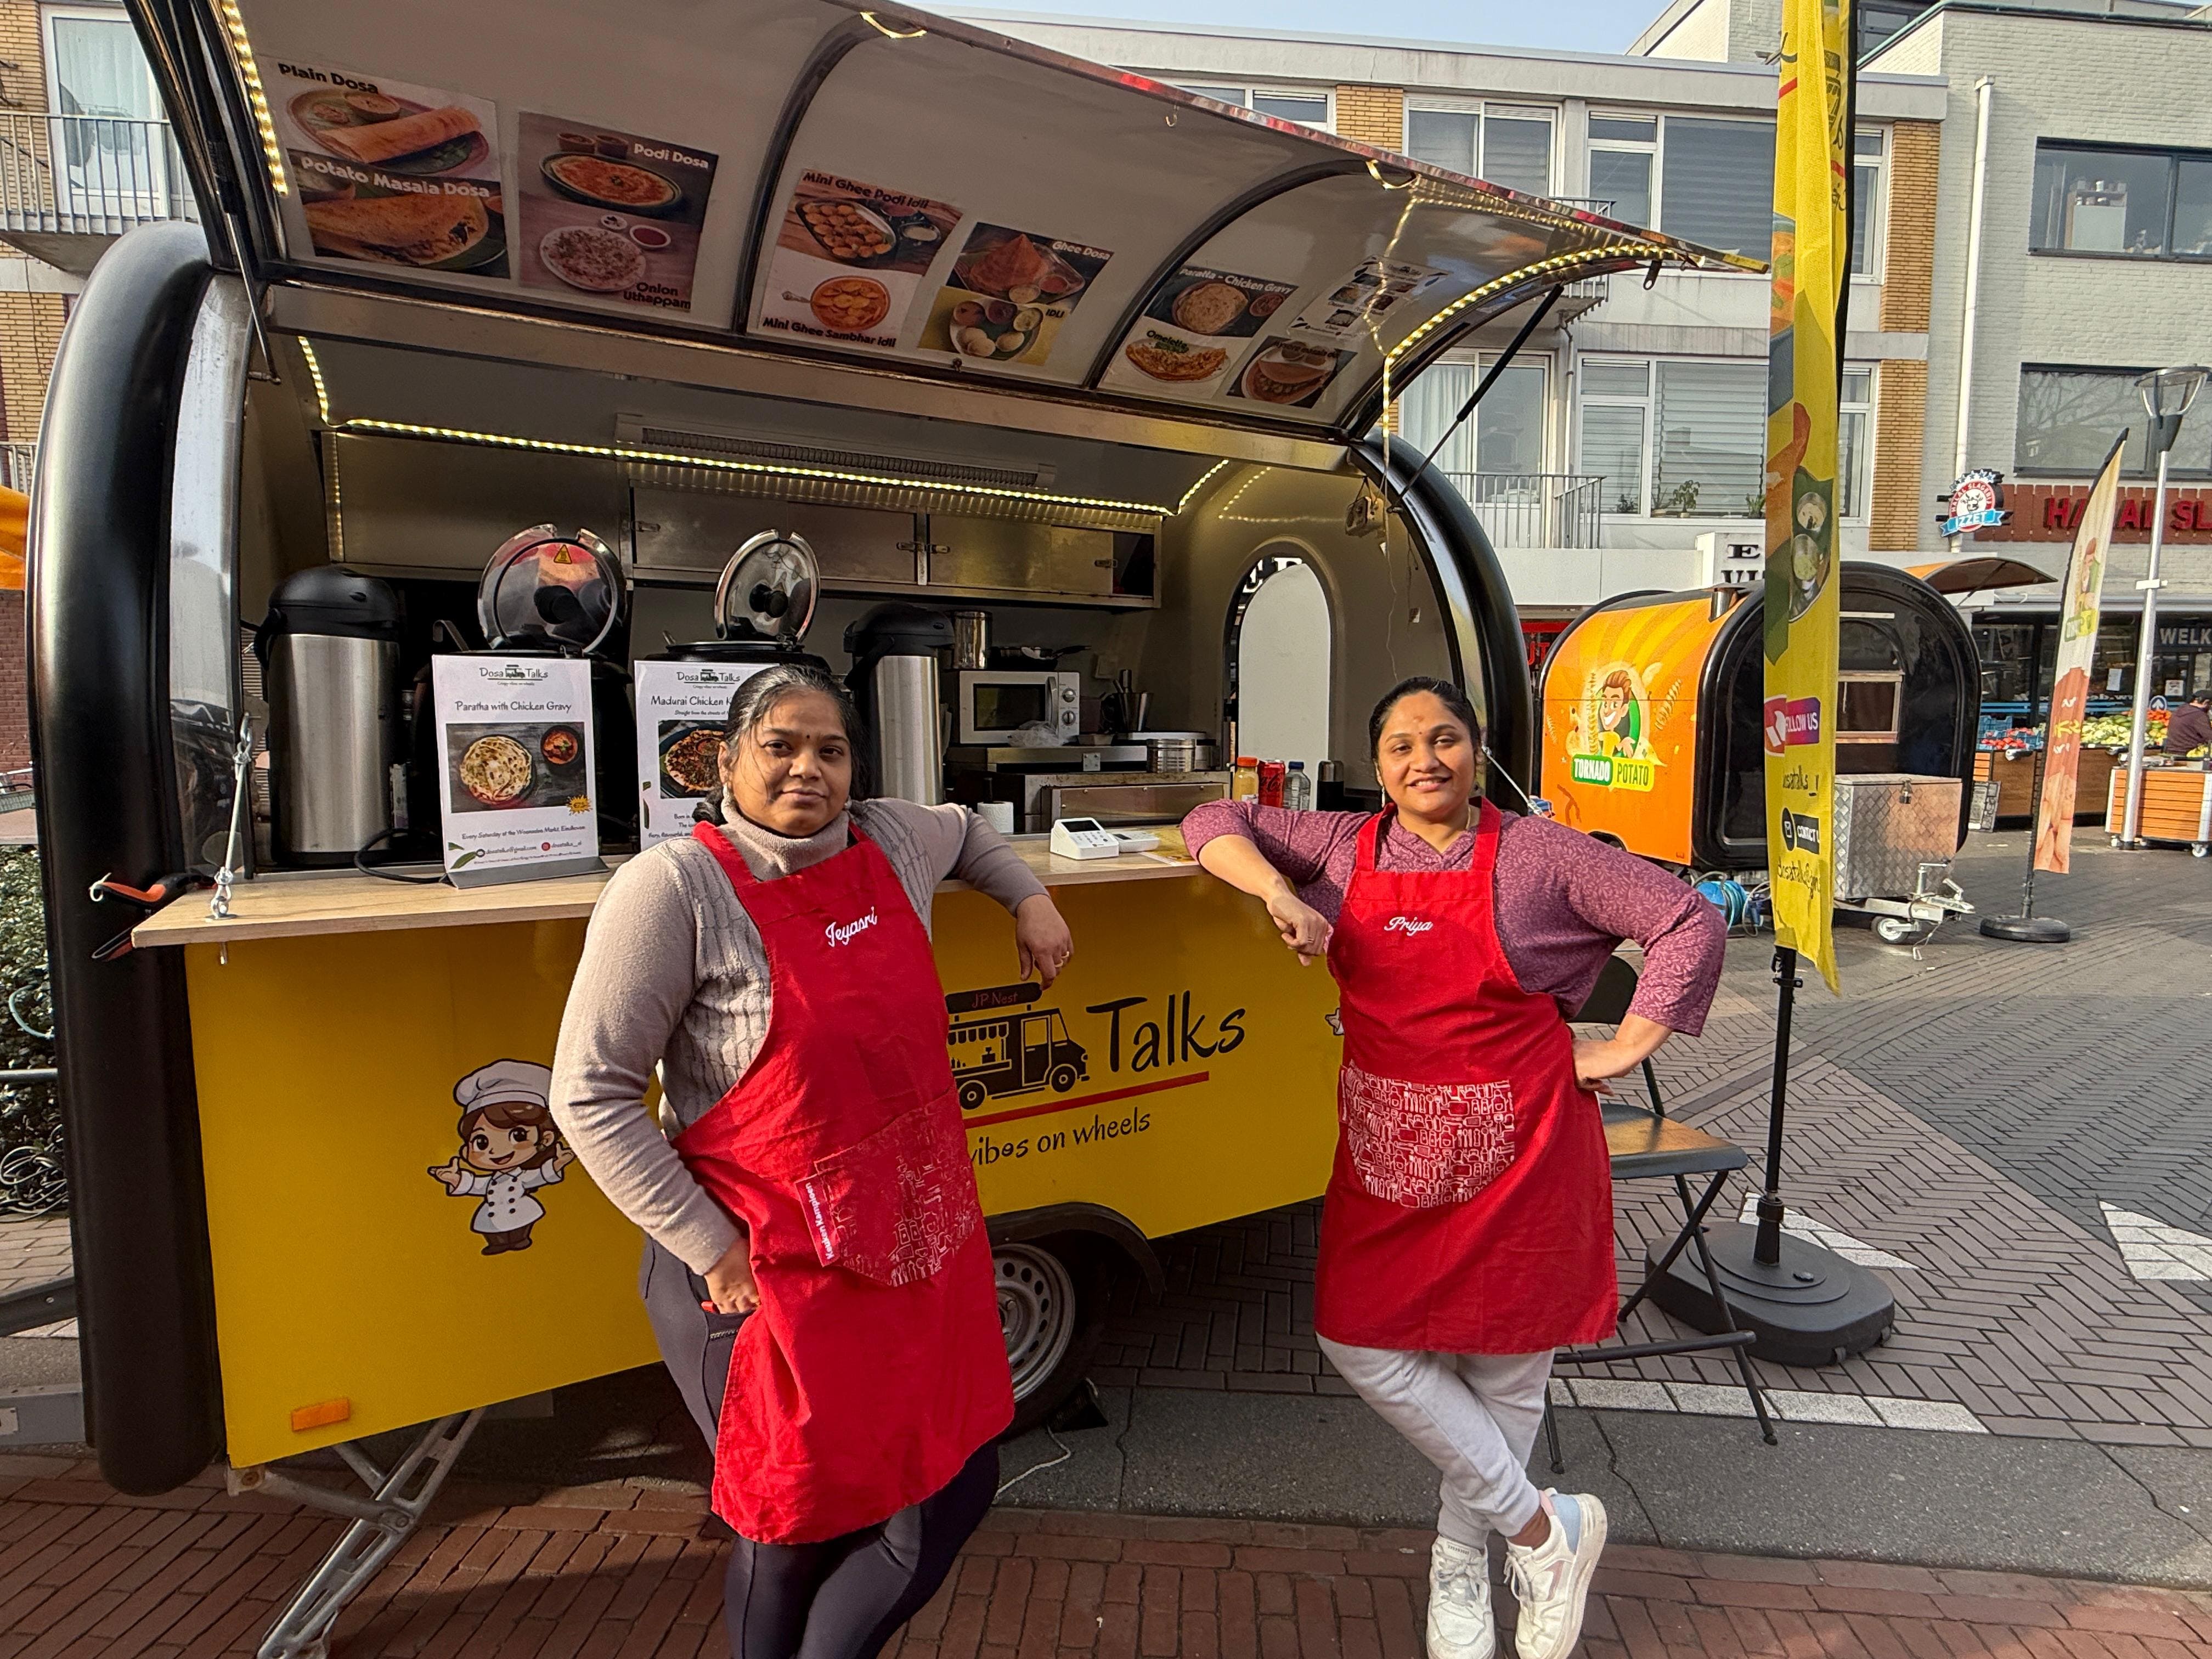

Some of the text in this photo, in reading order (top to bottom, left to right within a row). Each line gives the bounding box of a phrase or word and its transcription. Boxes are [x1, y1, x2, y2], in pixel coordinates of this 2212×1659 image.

[278, 63, 379, 94] Plain Dosa
[634, 144, 709, 168] Podi Dosa
[301, 157, 490, 198] Potato Masala Dosa
[803, 172, 832, 185] Mini
[836, 179, 871, 198] Ghee
[874, 190, 905, 205] Podi
[1052, 241, 1110, 260] Ghee Dosa
[636, 282, 678, 296] Onion
[1224, 275, 1264, 291] Chicken
[1265, 283, 1293, 294] Gravy
[763, 318, 789, 329] Mini
[791, 323, 823, 336] Ghee
[825, 330, 876, 343] Sambhar
[479, 668, 548, 678] Dosa Talks
[676, 672, 741, 681] Dosa Talks
[455, 701, 572, 714] Paratha with Chicken Gravy
[651, 696, 687, 706] Madurai
[689, 696, 724, 706] Chicken
[1807, 712, 1819, 730] US
[1574, 758, 1649, 786] TORNADO POTATO
[825, 906, 878, 947] Jeyasri
[1384, 916, 1434, 936] Priya
[972, 991, 1018, 1008] JP Nest
[1086, 990, 1246, 1073] Talks
[1037, 1132, 1065, 1153] on
[1073, 1106, 1150, 1145] wheels
